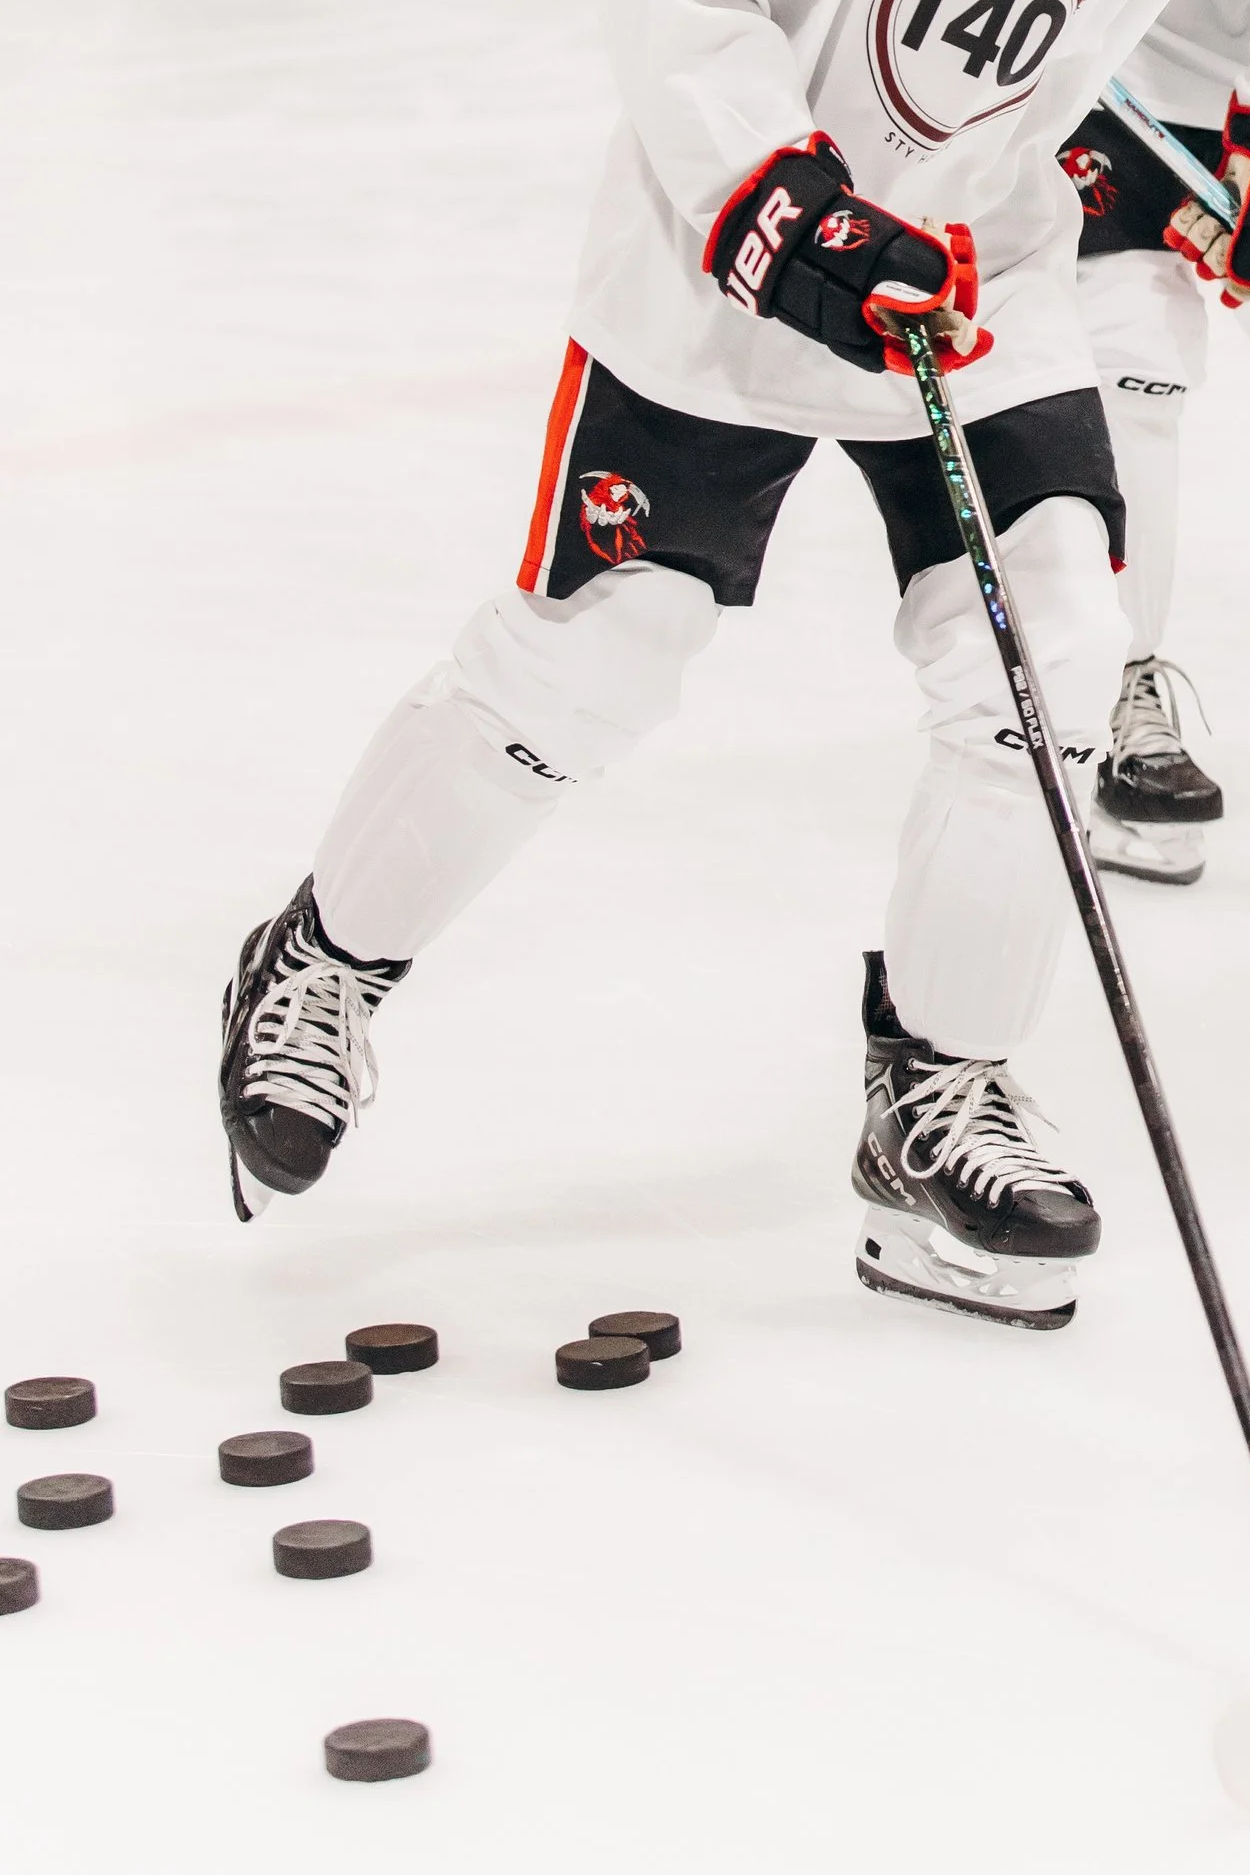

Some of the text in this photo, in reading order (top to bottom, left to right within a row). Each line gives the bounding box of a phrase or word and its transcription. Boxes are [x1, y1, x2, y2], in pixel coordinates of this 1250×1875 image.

[884, 131, 915, 158] STY
[505, 743, 578, 783] CC
[994, 728, 1096, 764] CM
[867, 1131, 917, 1207] CCM
